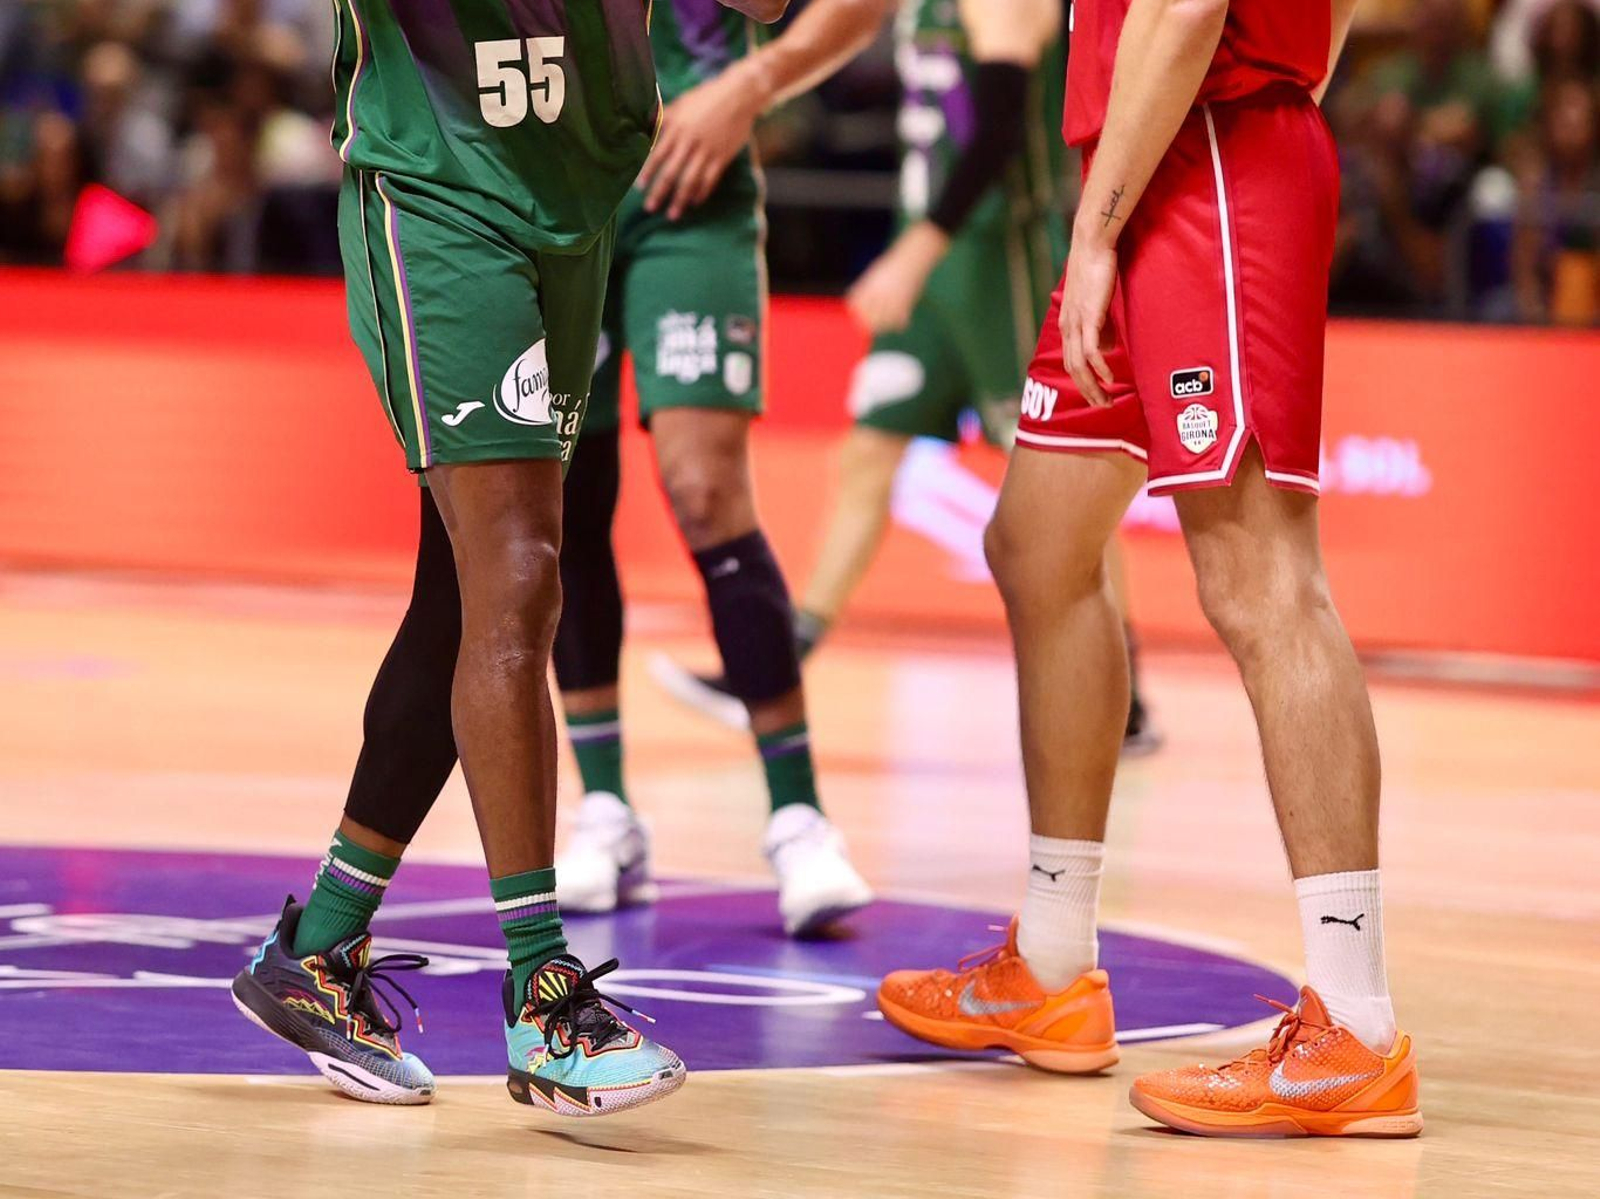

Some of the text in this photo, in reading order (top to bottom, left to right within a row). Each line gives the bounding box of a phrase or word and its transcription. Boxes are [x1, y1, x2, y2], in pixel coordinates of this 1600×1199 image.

[474, 36, 566, 128] 55
[1174, 378, 1203, 394] acb
[1182, 419, 1211, 430] BASQUET
[1181, 428, 1215, 442] GIRONA
